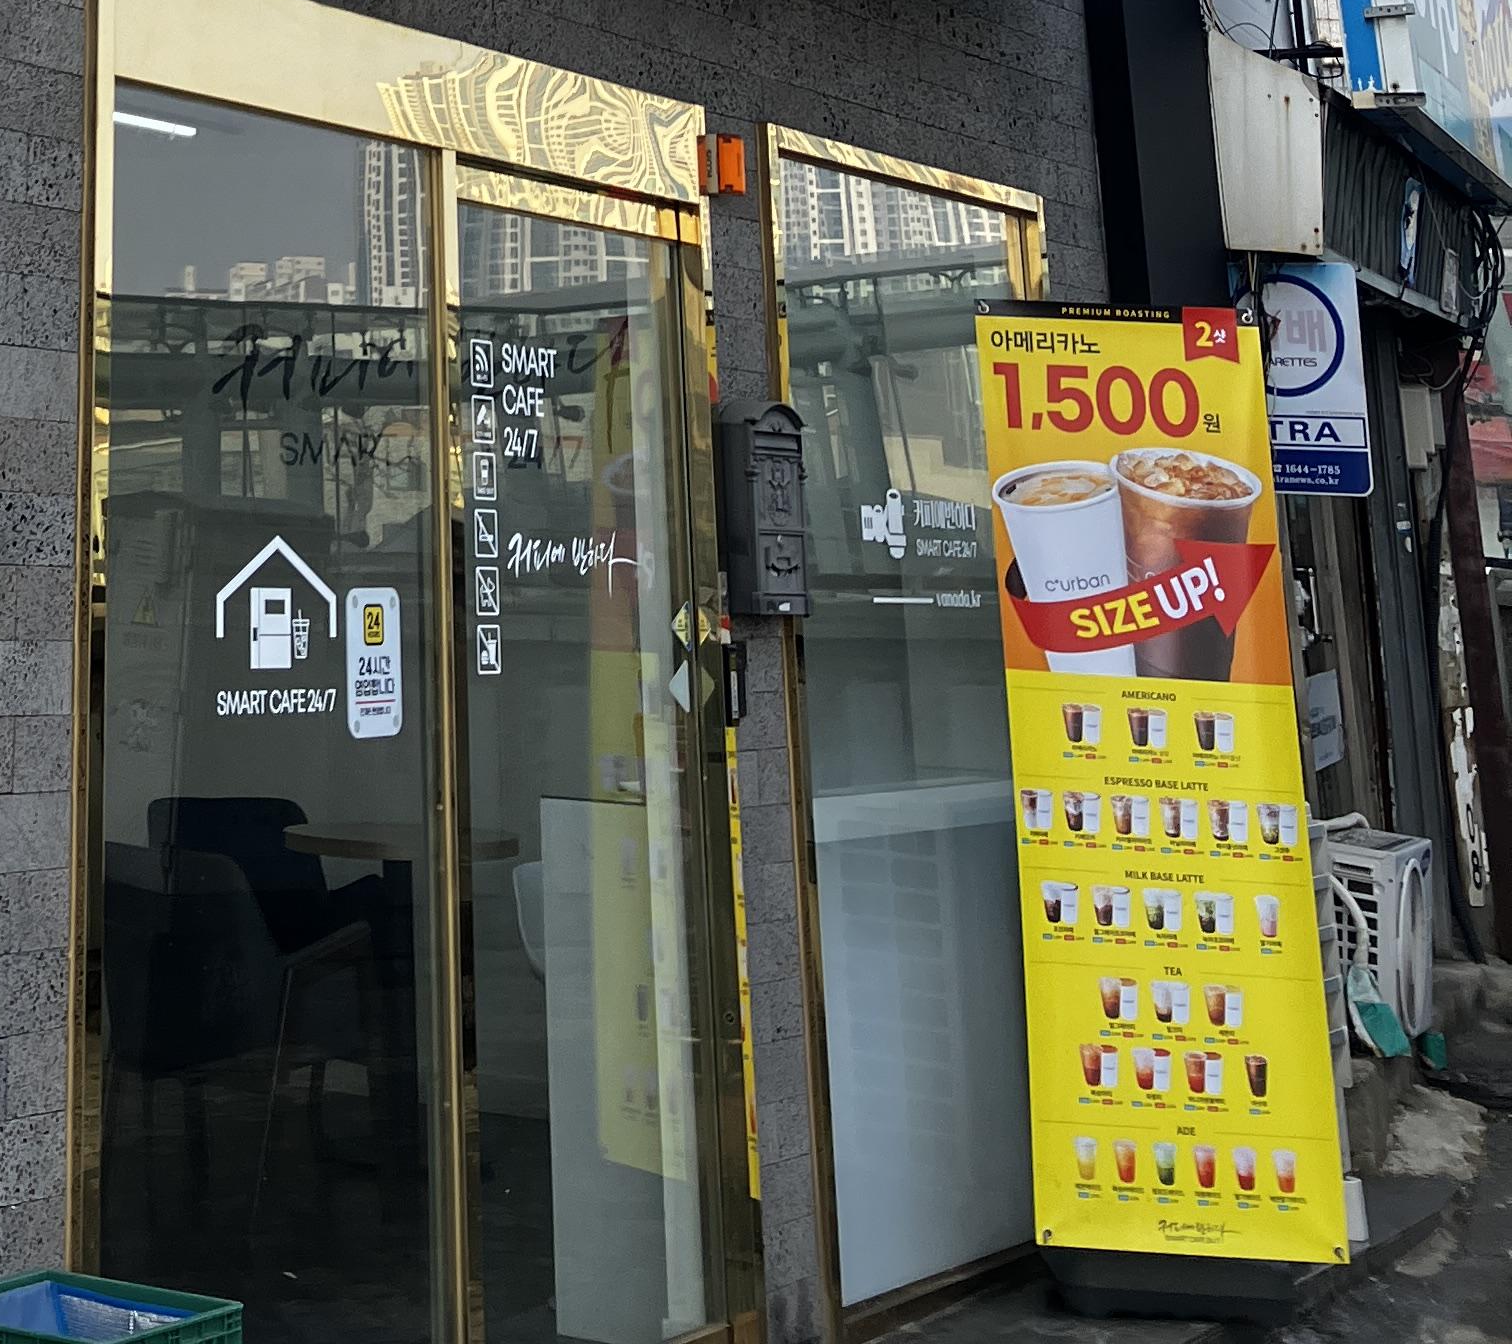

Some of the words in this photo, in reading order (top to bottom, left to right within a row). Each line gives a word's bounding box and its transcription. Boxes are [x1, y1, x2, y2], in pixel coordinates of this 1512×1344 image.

[1061, 306, 1111, 316] PREMIUM
[1115, 309, 1170, 319] ROASTING
[990, 330, 1101, 354] 아메리카노
[501, 343, 557, 378] SMART
[502, 384, 544, 418] CAFE
[1270, 421, 1341, 442] TRA
[504, 426, 538, 459] 24/7
[1286, 464, 1340, 475] 1644-1785
[916, 538, 942, 556] SMART
[1069, 591, 1160, 638] SIZE
[1153, 557, 1226, 619] UP!
[366, 612, 380, 630] 24
[359, 656, 391, 676] 24시간
[217, 688, 267, 716] SMART
[269, 688, 307, 715] CAFE
[307, 688, 337, 714] 24/7
[1104, 776, 1153, 788] ESPRESSO
[1154, 779, 1179, 790] BASE
[1180, 781, 1209, 792] LATTE
[1125, 870, 1148, 881] MILK
[1150, 871, 1174, 882] BASE
[1176, 873, 1205, 884] LATTE
[1164, 966, 1183, 977] TEA
[1177, 1126, 1197, 1137] ADE
